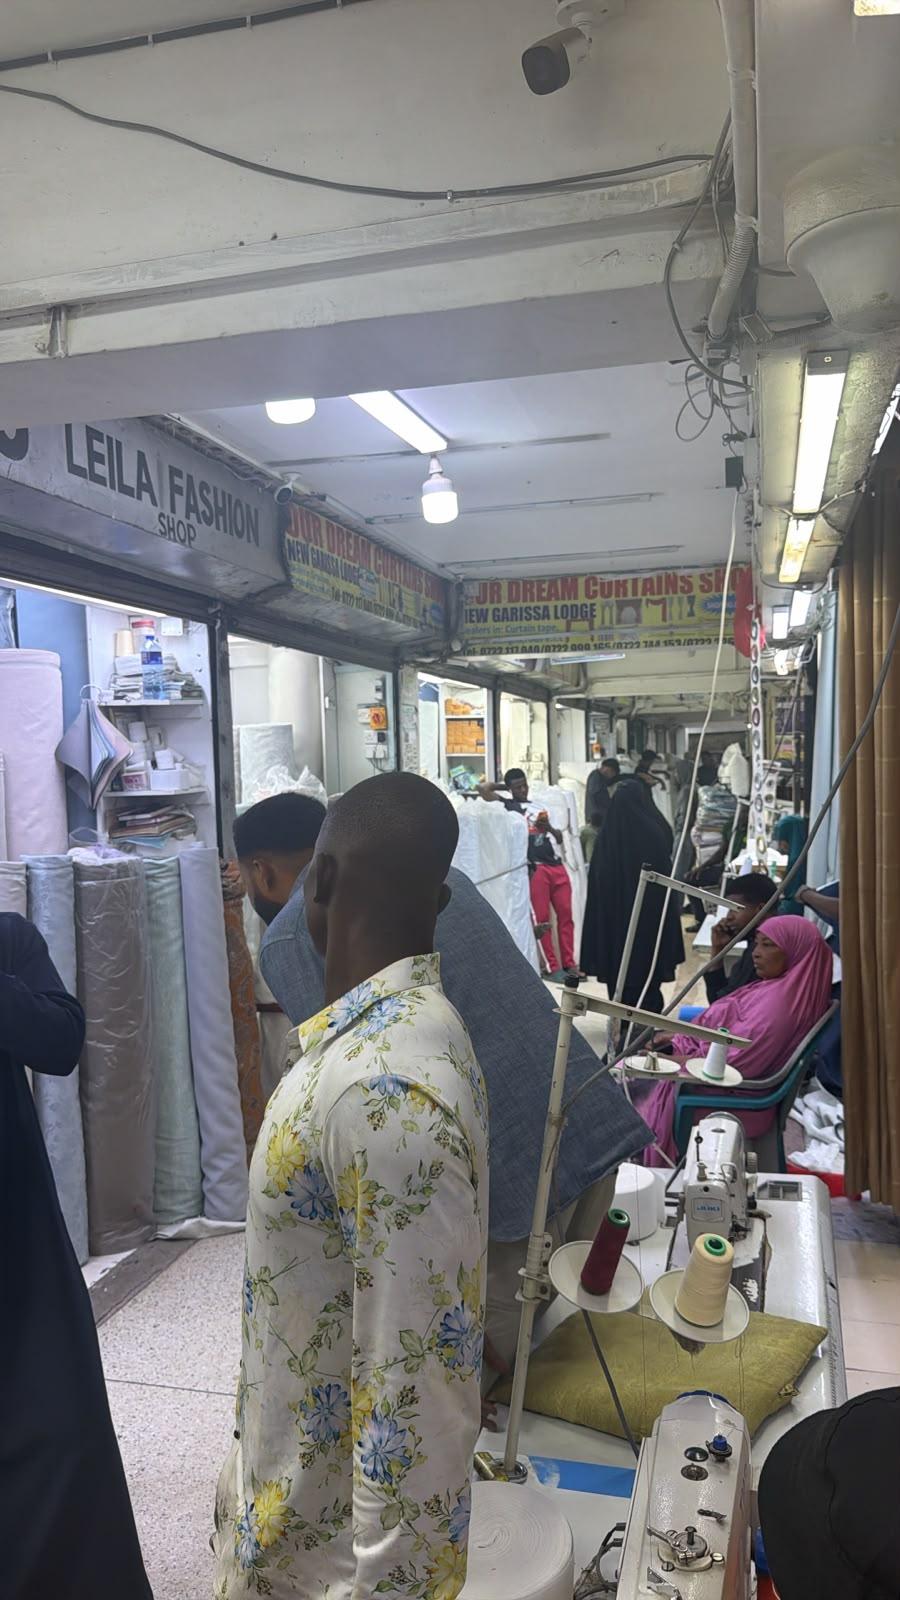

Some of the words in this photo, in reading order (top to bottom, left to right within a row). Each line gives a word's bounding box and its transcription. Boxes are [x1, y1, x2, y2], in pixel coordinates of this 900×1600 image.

[65, 423, 157, 507] LEILA
[168, 465, 260, 546] FASHION
[158, 511, 197, 546] SHOP
[507, 575, 579, 603] DREAM
[584, 572, 694, 599] CURTAINS
[492, 605, 550, 622] GARISSA
[554, 603, 597, 619] LODGE
[505, 624, 535, 633] Curtain
